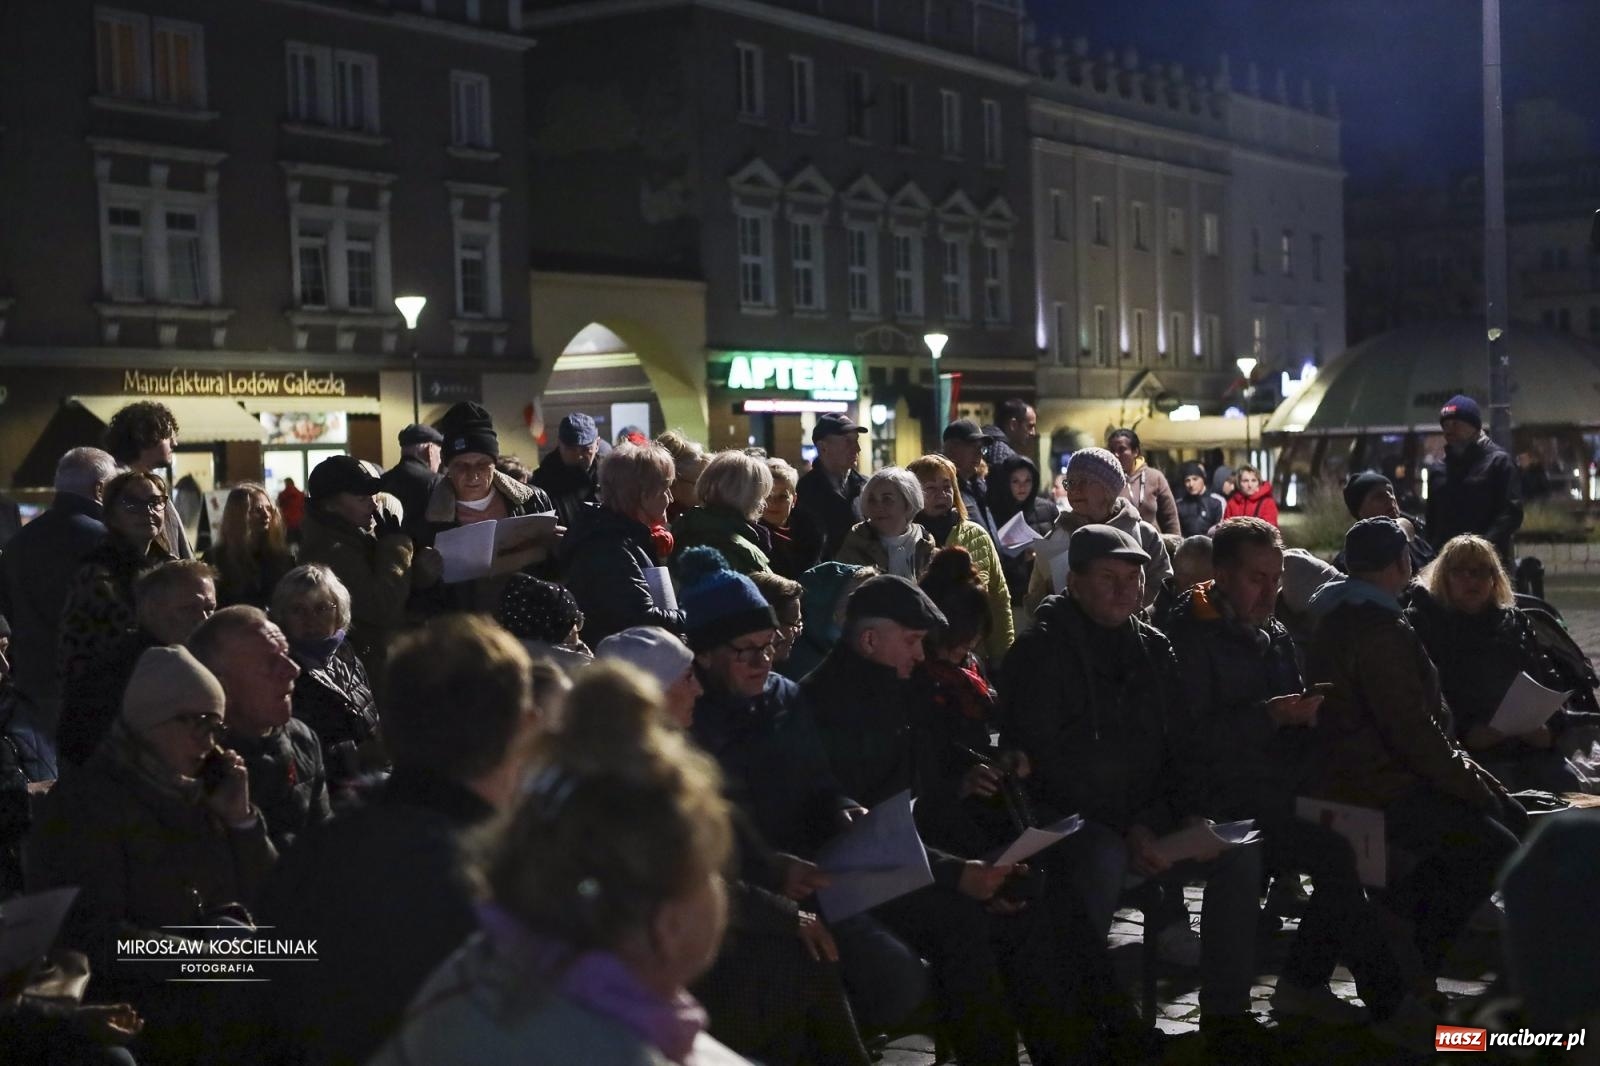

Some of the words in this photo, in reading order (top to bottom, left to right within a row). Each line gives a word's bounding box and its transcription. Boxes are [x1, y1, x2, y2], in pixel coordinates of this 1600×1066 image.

[124, 367, 224, 395] Manufaktura
[229, 371, 279, 396] Lodów
[283, 369, 345, 396] Gałeczka
[728, 355, 859, 391] APTEKA
